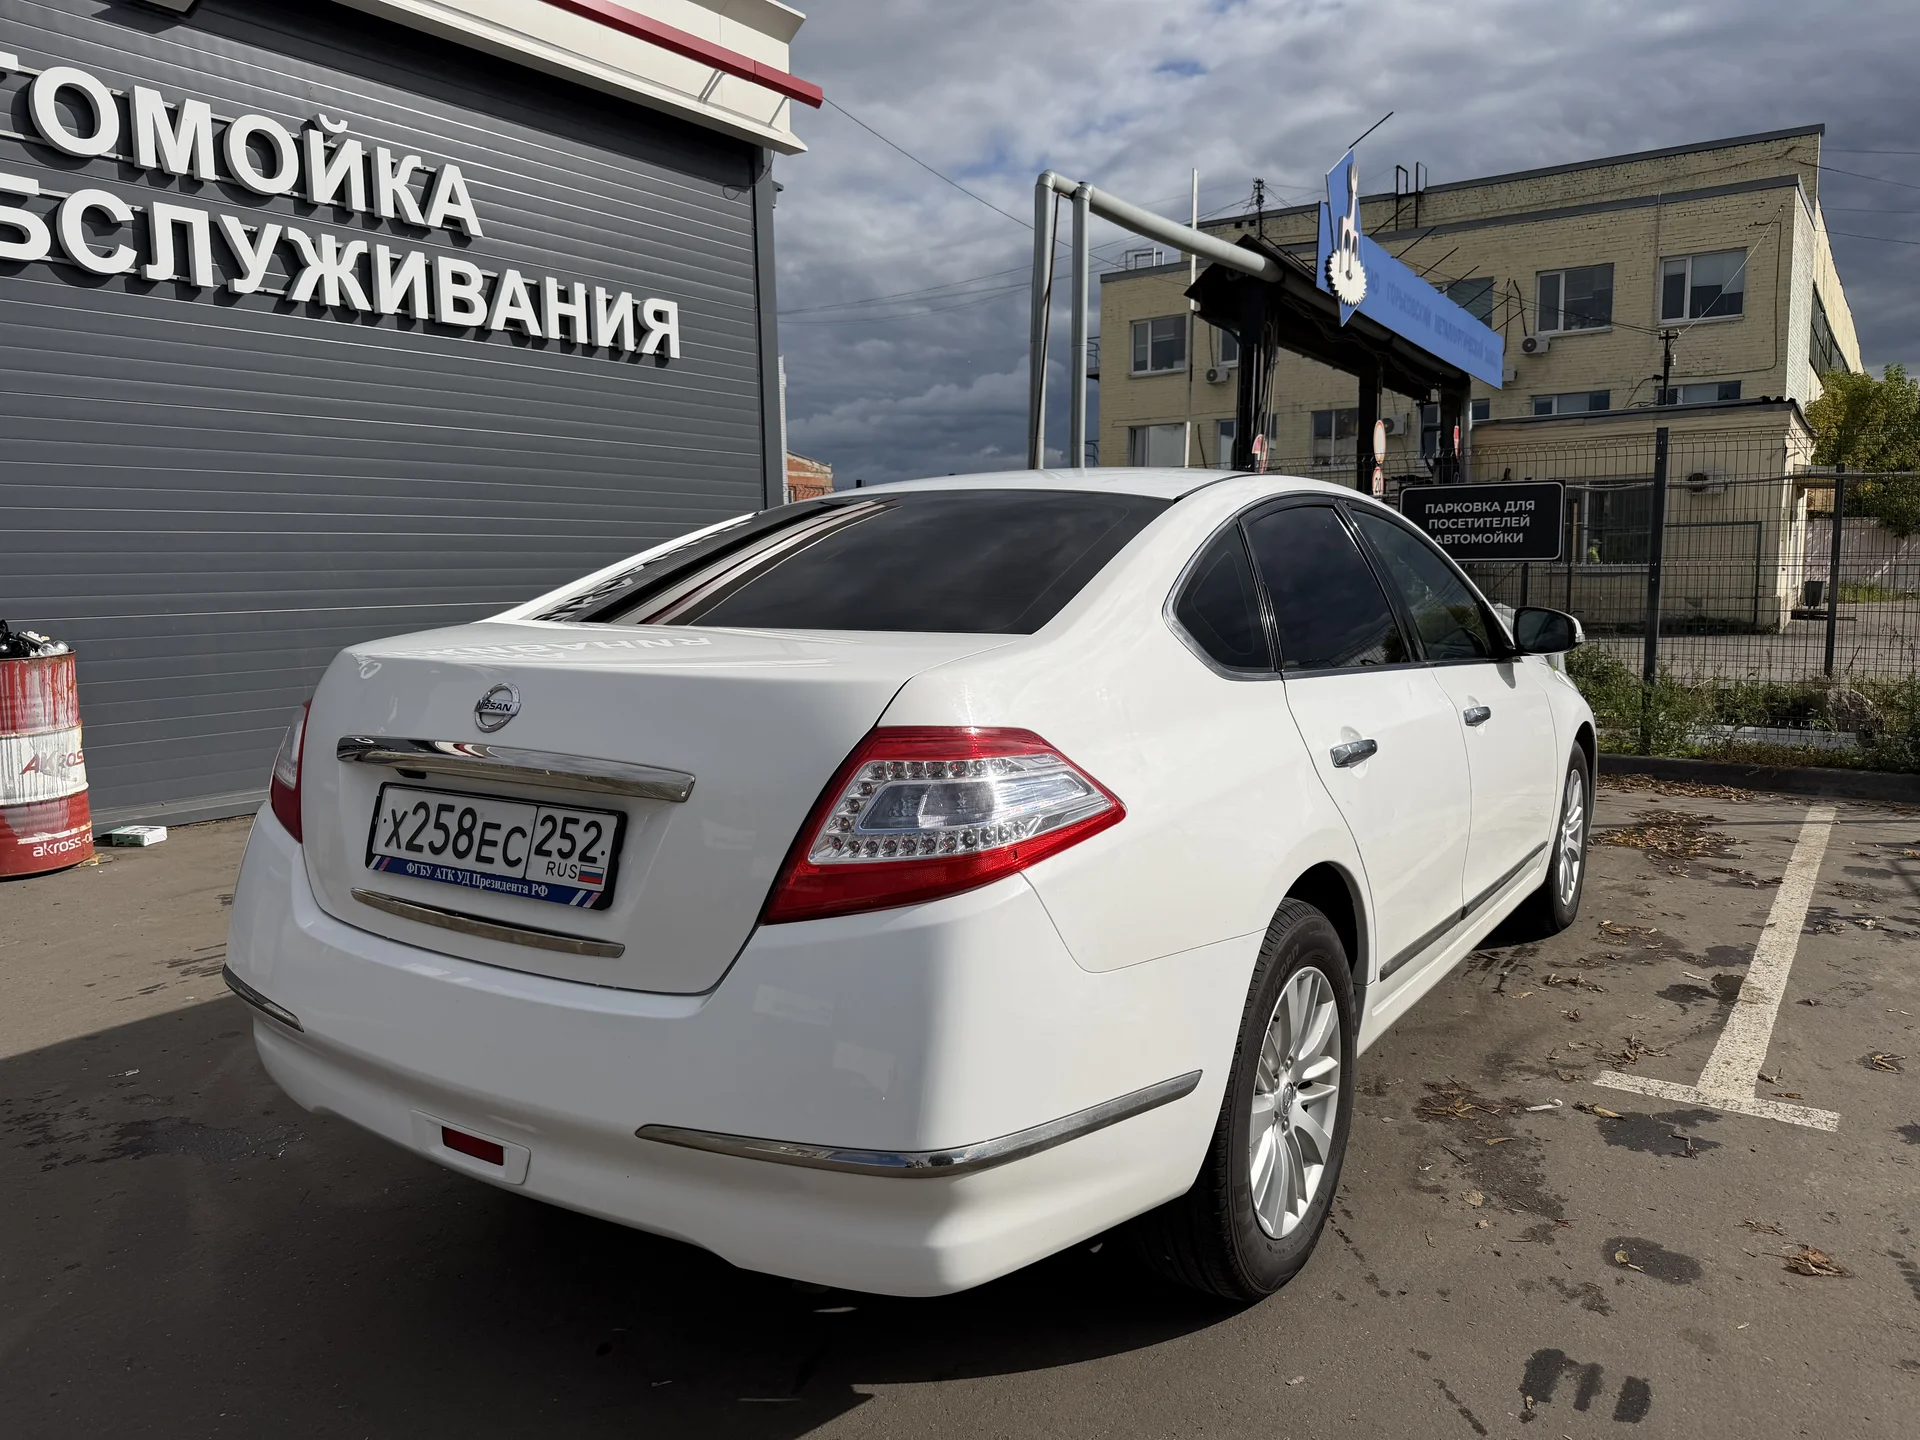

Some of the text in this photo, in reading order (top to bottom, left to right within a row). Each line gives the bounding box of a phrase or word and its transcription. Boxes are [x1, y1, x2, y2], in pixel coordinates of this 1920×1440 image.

[1425, 500, 1535, 514] ПАРКОВКА ДЛЯ
[1428, 514, 1531, 530] ПОСЕТИТЕЛЕЙ
[1434, 531, 1524, 545] АВТОМОЙКИ
[477, 700, 513, 712] NISSAN
[384, 801, 603, 868] Х258ЕС 252
[545, 861, 578, 880] RUS
[406, 862, 549, 898] ФГБУ АТК УД Президента РФ
